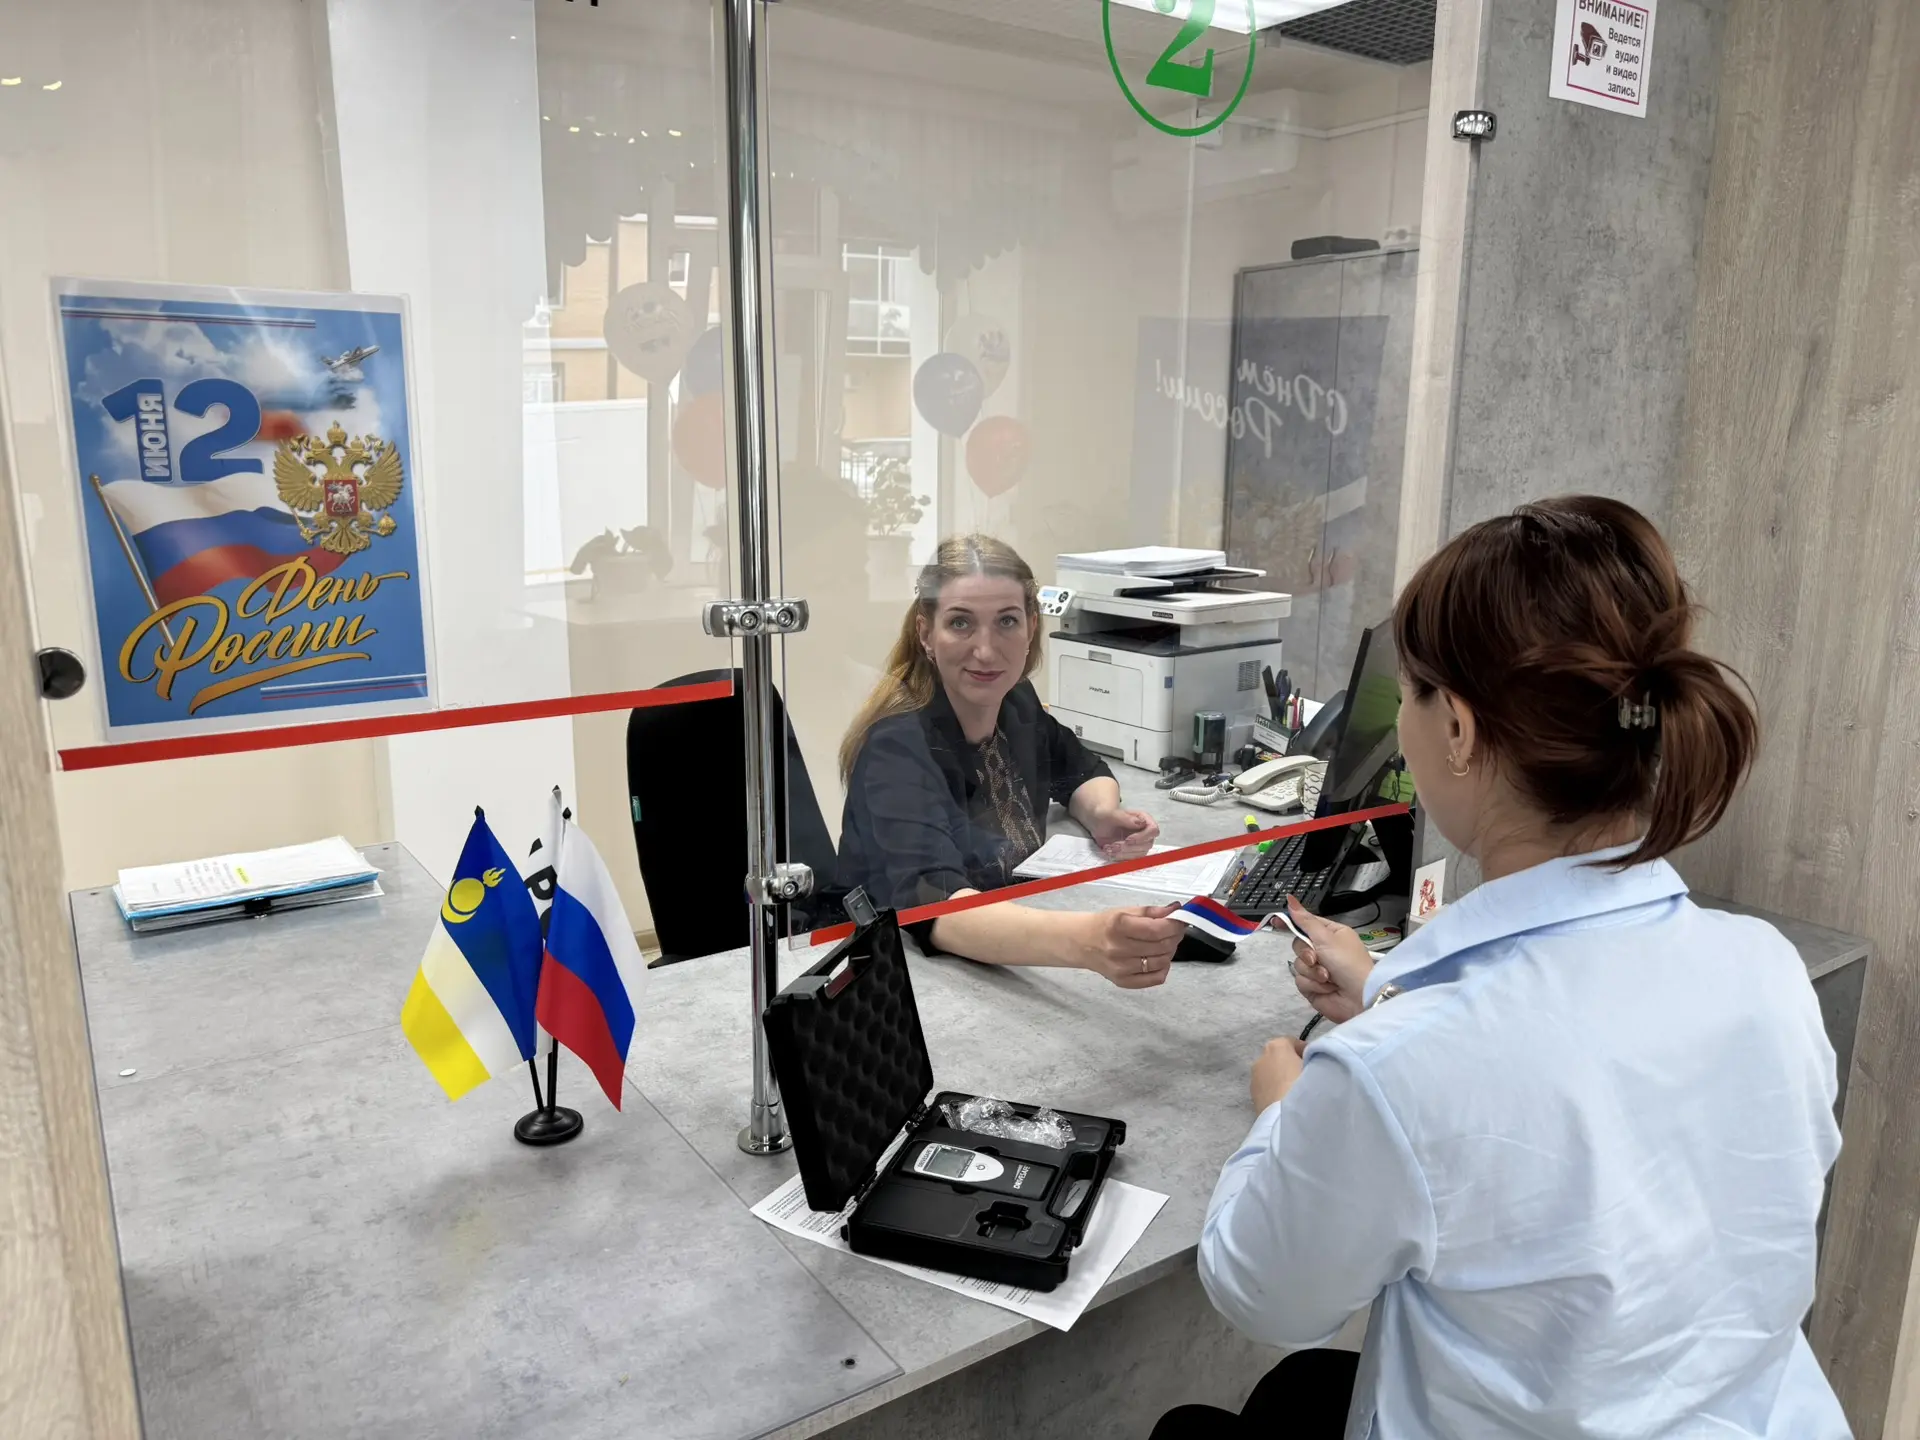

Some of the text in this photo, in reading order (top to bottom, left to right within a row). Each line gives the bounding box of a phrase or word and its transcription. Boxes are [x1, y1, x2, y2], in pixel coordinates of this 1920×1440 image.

[1579, 0, 1644, 30] ВНИМАНИЕ!
[1608, 28, 1641, 48] Ведется
[1146, 0, 1215, 97] 2
[1606, 65, 1637, 81] и видео
[1615, 50, 1639, 65] аудио
[1608, 82, 1635, 98] запись
[101, 378, 265, 484] 12
[137, 392, 170, 477] ИЮНЯ
[237, 556, 409, 624] День
[118, 595, 376, 701] России
